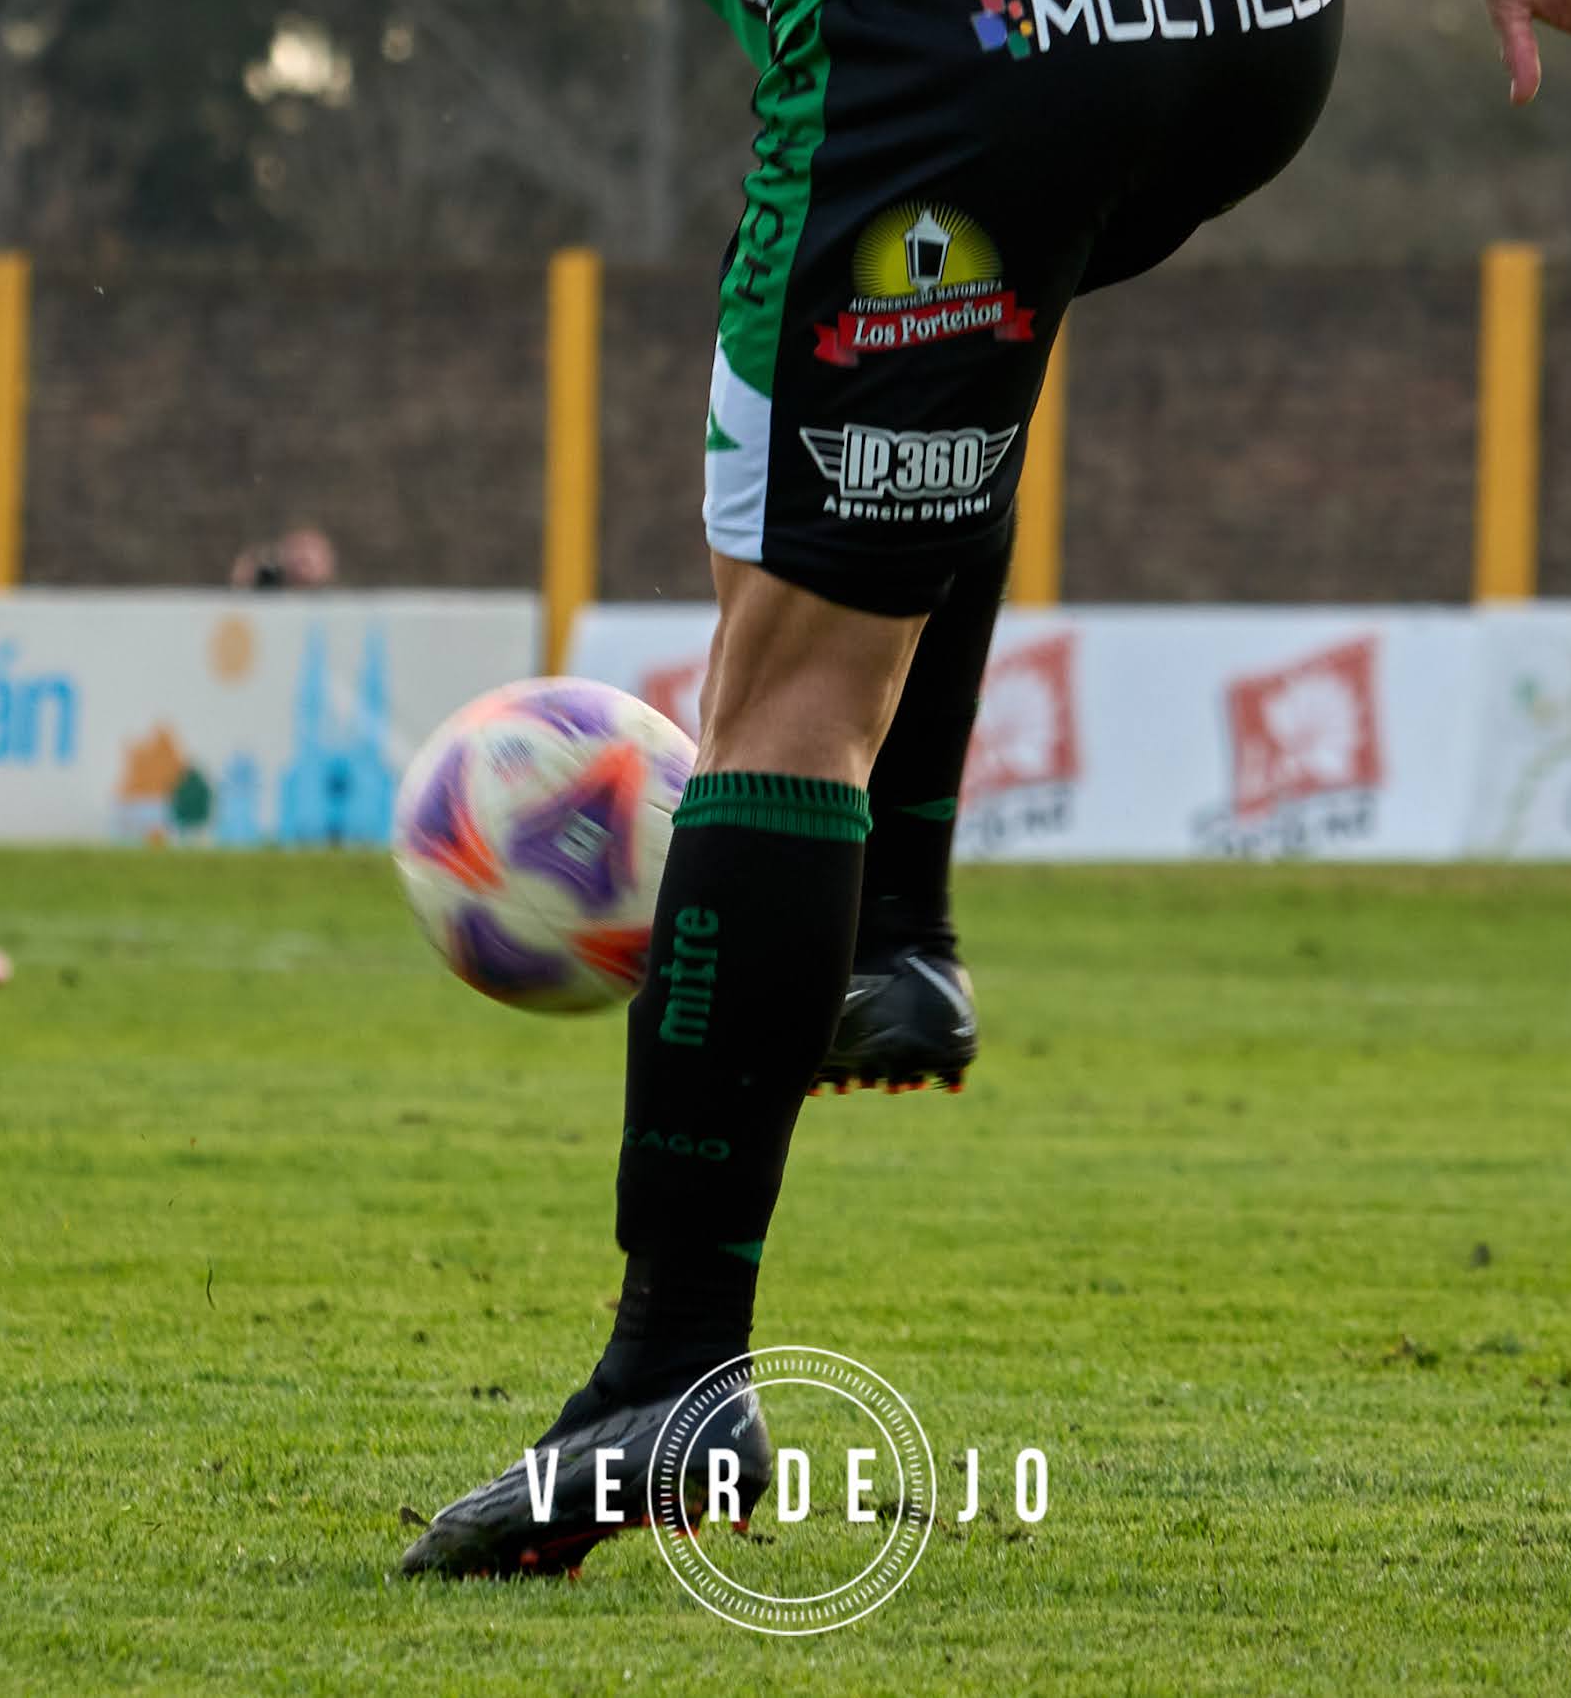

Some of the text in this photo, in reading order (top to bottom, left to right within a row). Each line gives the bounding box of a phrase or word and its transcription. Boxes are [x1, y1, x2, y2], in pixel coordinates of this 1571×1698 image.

[853, 301, 1004, 348] Los Porteños
[822, 492, 991, 523] Agencia Digital
[659, 906, 719, 1046] mitre
